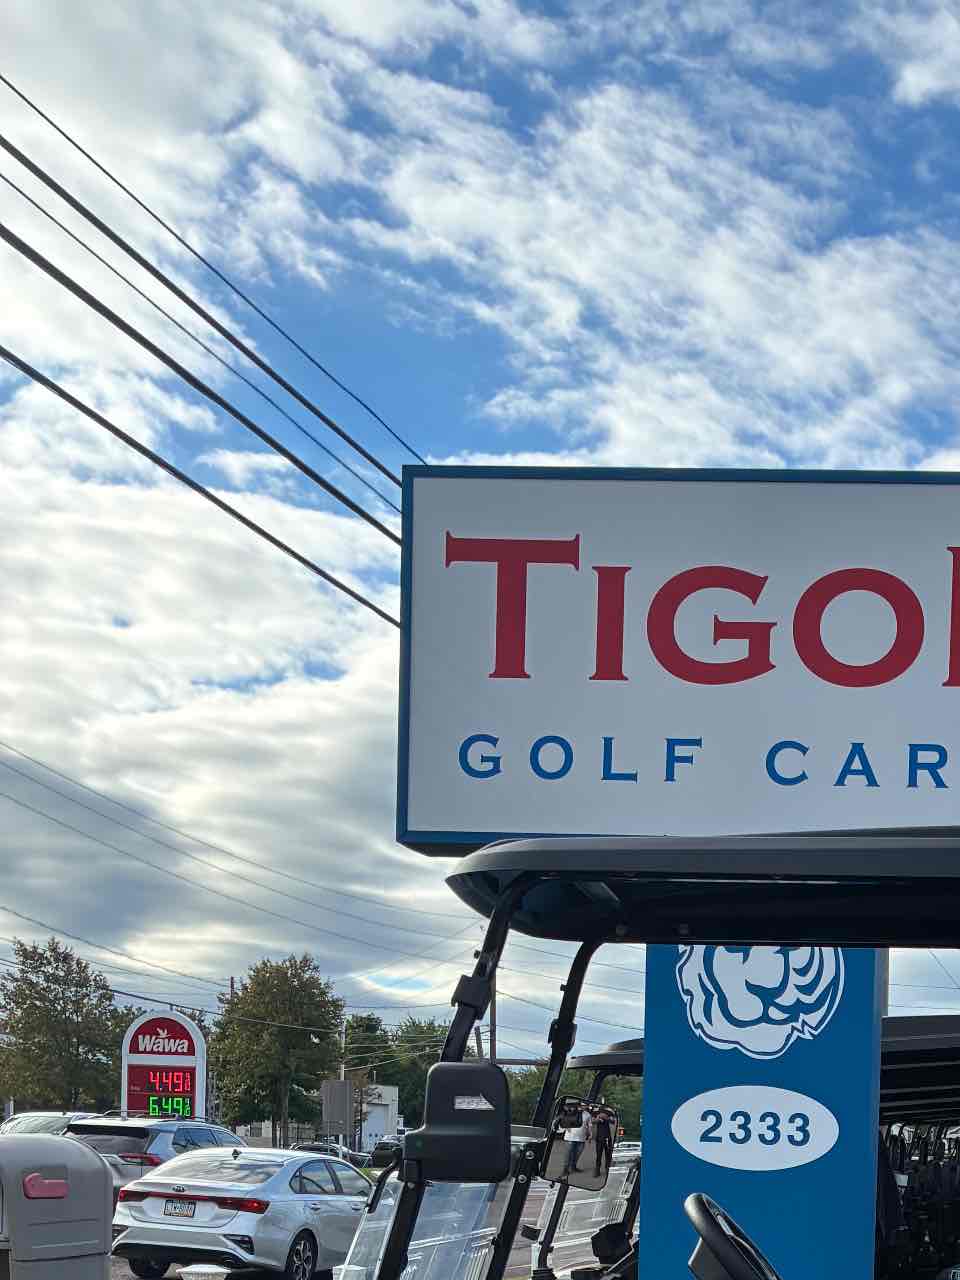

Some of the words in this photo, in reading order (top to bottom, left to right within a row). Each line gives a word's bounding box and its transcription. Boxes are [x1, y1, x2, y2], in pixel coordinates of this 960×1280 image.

[458, 733, 703, 784] GOLF
[138, 1034, 189, 1053] Wawa
[699, 1109, 811, 1147] 2333
